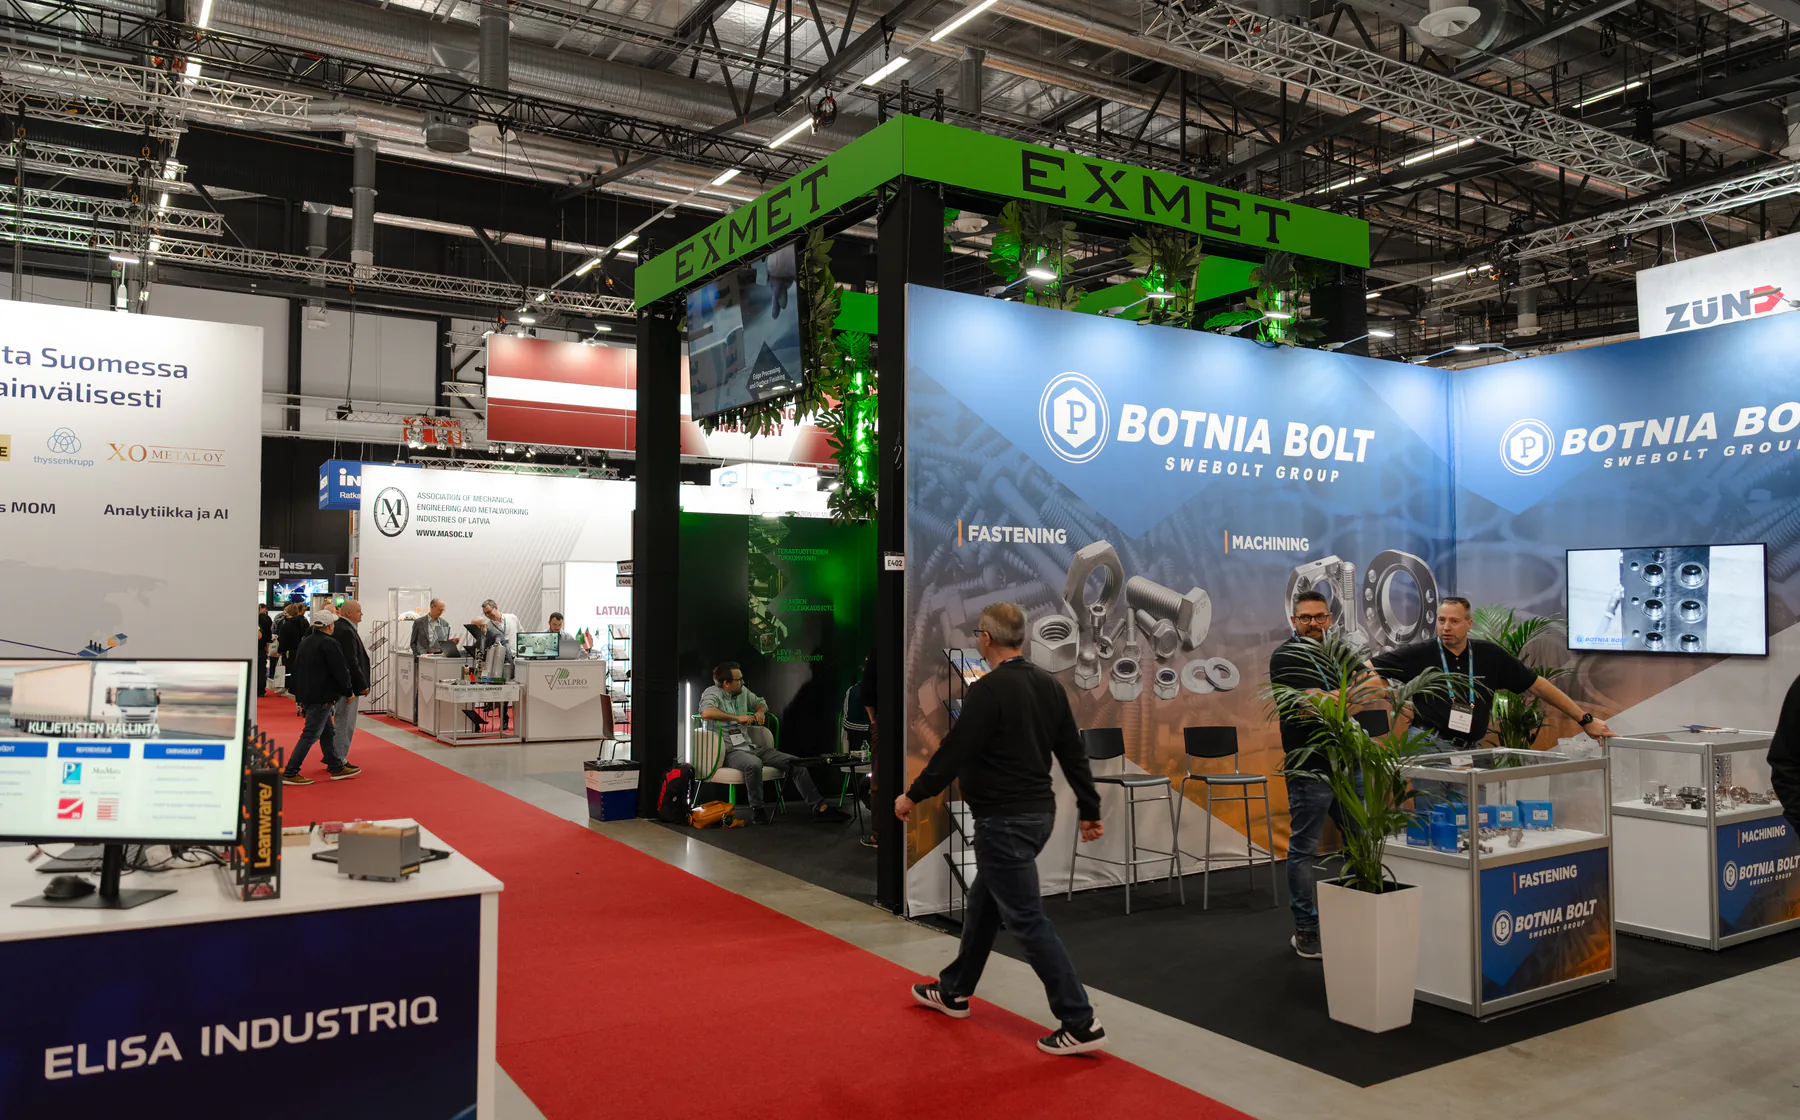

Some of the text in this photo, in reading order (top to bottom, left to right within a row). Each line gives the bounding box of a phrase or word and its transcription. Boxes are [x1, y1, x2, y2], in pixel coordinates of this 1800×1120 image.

[1021, 149, 1290, 245] EXMET
[675, 164, 829, 284] EXMET
[41, 347, 188, 379] Suomessa
[1117, 403, 1375, 464] BOTNIA BOLT
[1560, 411, 1718, 457] BOTNIA
[33, 455, 94, 467] thyssenkrupp
[107, 442, 223, 463] XO METAL OY
[1603, 439, 1800, 469] SWEBOLT GROU
[1165, 456, 1340, 484] SWEBOLT GROUP
[416, 492, 461, 501] ASSOCIATION
[472, 495, 515, 504] MECHANICAL
[11, 502, 56, 515] MOM
[104, 503, 229, 521] Analytiikka ja AI
[416, 503, 462, 513] ENGINEERING
[478, 506, 529, 516] METALWORKING
[416, 515, 457, 524] INDUSTRIES
[468, 517, 490, 525] LATVIA
[416, 529, 473, 539] WWW.MASOC.LV
[968, 524, 1067, 545] FASTENING
[1232, 534, 1310, 553] MACHINING
[259, 551, 276, 559] E401
[887, 559, 903, 567] E402
[258, 569, 277, 577] E409
[596, 606, 630, 616] LATVIA
[28, 721, 160, 735] KULJETUSTEN HALLINTA
[1741, 825, 1786, 844] MACHINING
[1519, 864, 1578, 889] FASTENING
[1739, 855, 1800, 881] BOTNIA BOLT
[1749, 872, 1792, 886] SWEBOLT GROUP
[1514, 899, 1597, 933] BOTNIA BOLT
[1529, 919, 1586, 939] SWEBOLT GROUP
[44, 995, 439, 1081] ELISA INDUSTRIQ
